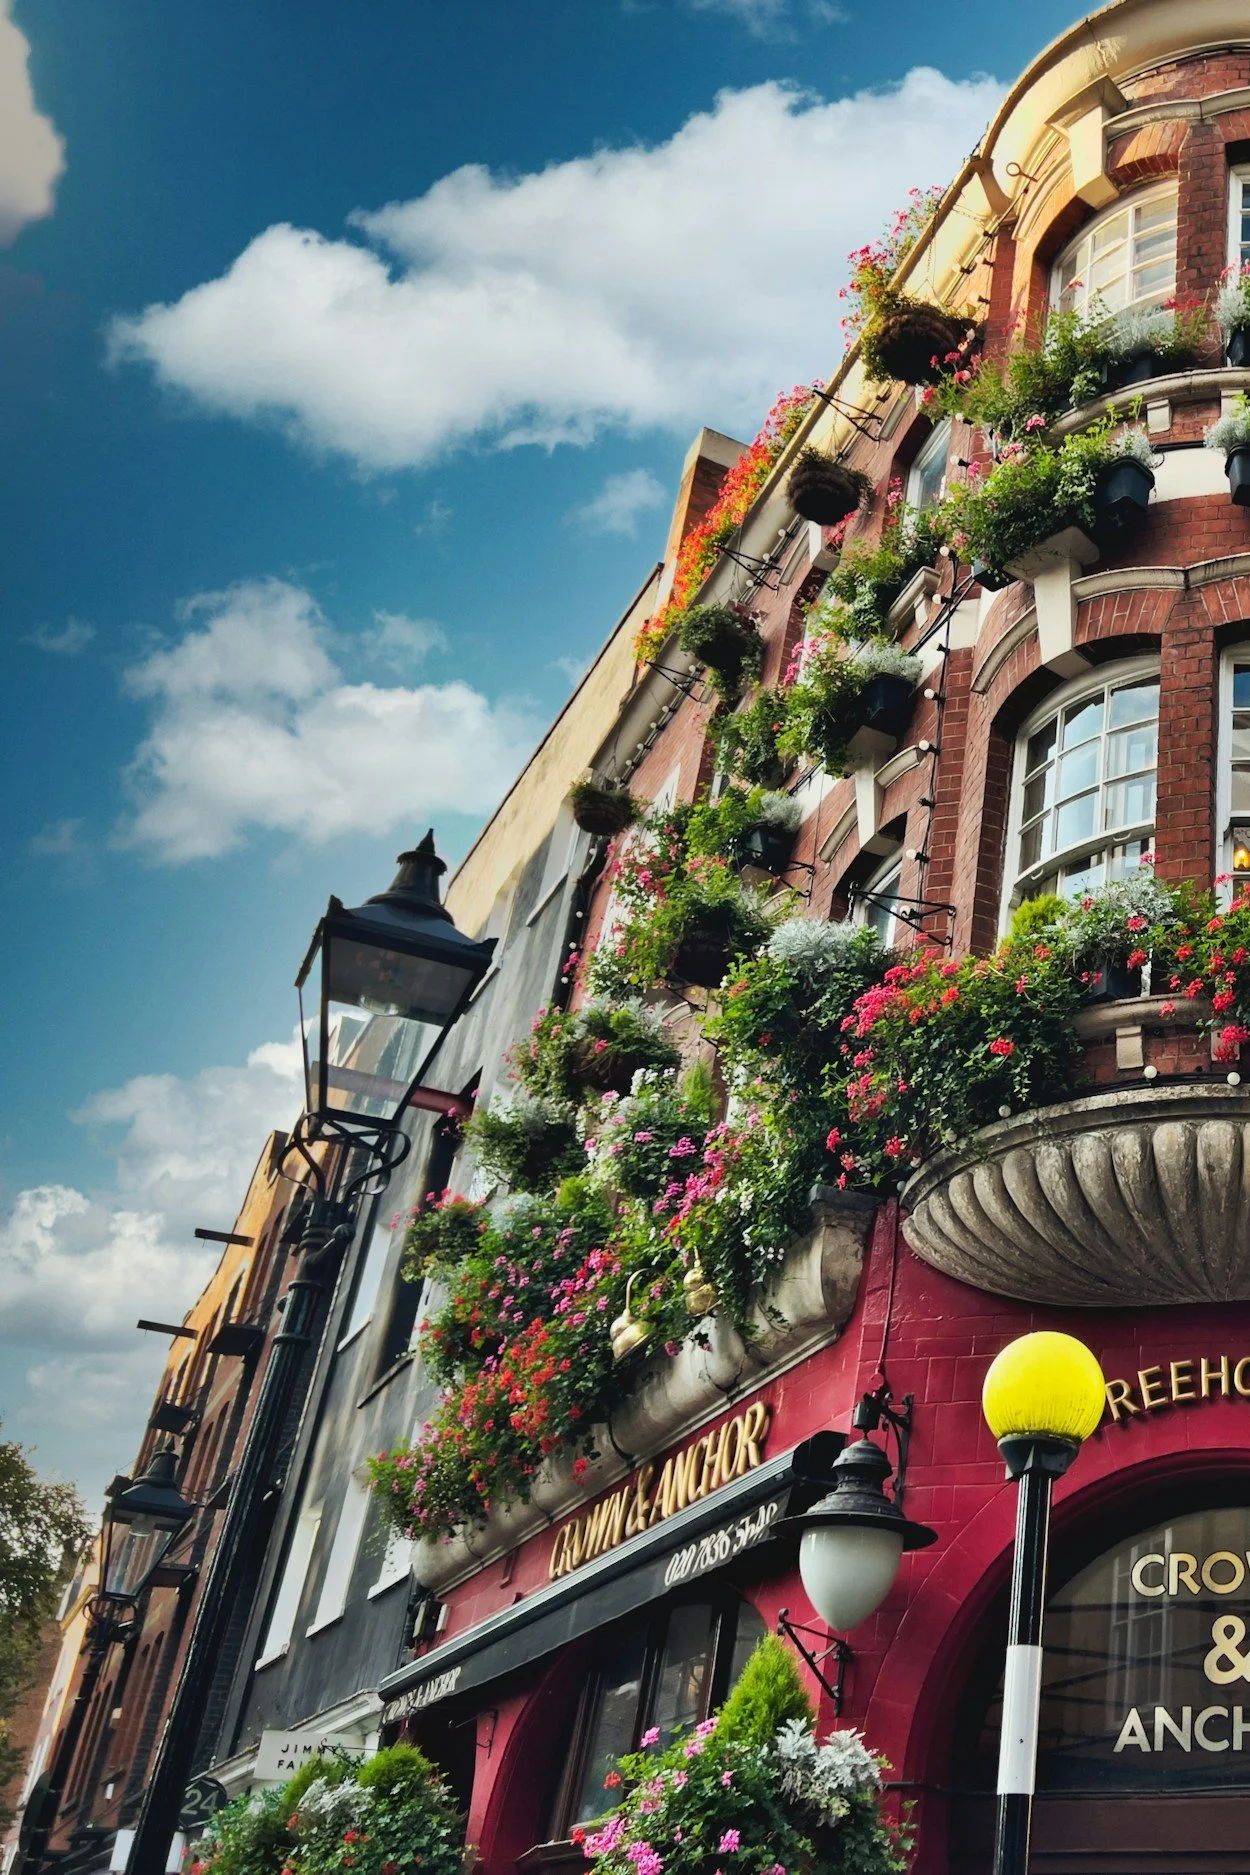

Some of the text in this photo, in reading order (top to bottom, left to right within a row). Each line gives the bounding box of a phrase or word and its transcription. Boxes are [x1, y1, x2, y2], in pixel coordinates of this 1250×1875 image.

[549, 1401, 767, 1580] CROWN & ANCHOR
[664, 1543, 697, 1586] 020
[691, 1523, 734, 1573] 7836
[180, 1789, 219, 1815] 24
